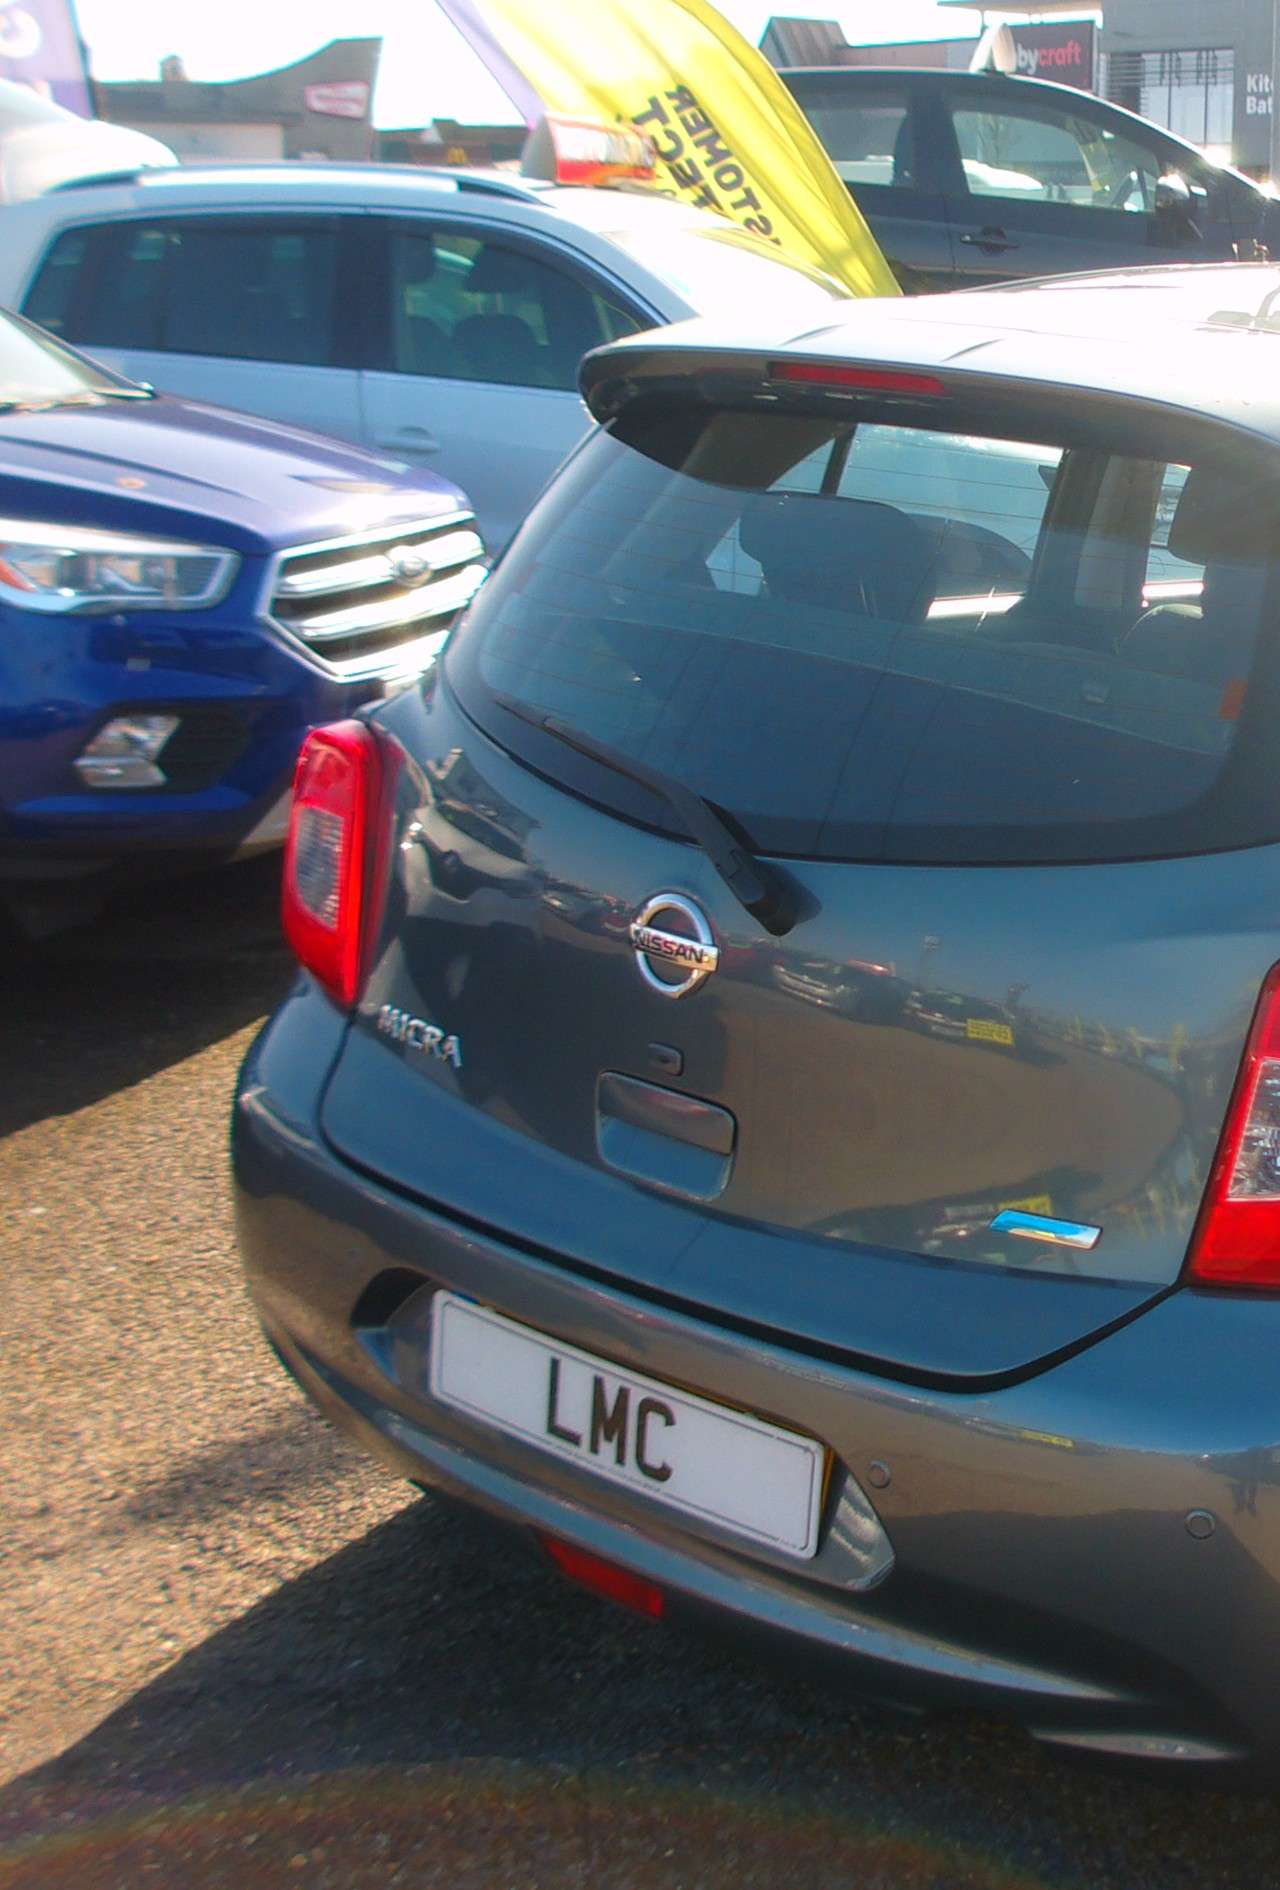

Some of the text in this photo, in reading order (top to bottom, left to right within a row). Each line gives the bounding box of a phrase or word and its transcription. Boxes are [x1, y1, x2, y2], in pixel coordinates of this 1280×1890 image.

[1017, 40, 1082, 75] bycraft
[636, 929, 705, 964] NISSAN
[378, 1004, 463, 1068] MICRA
[545, 1356, 677, 1484] LMC
